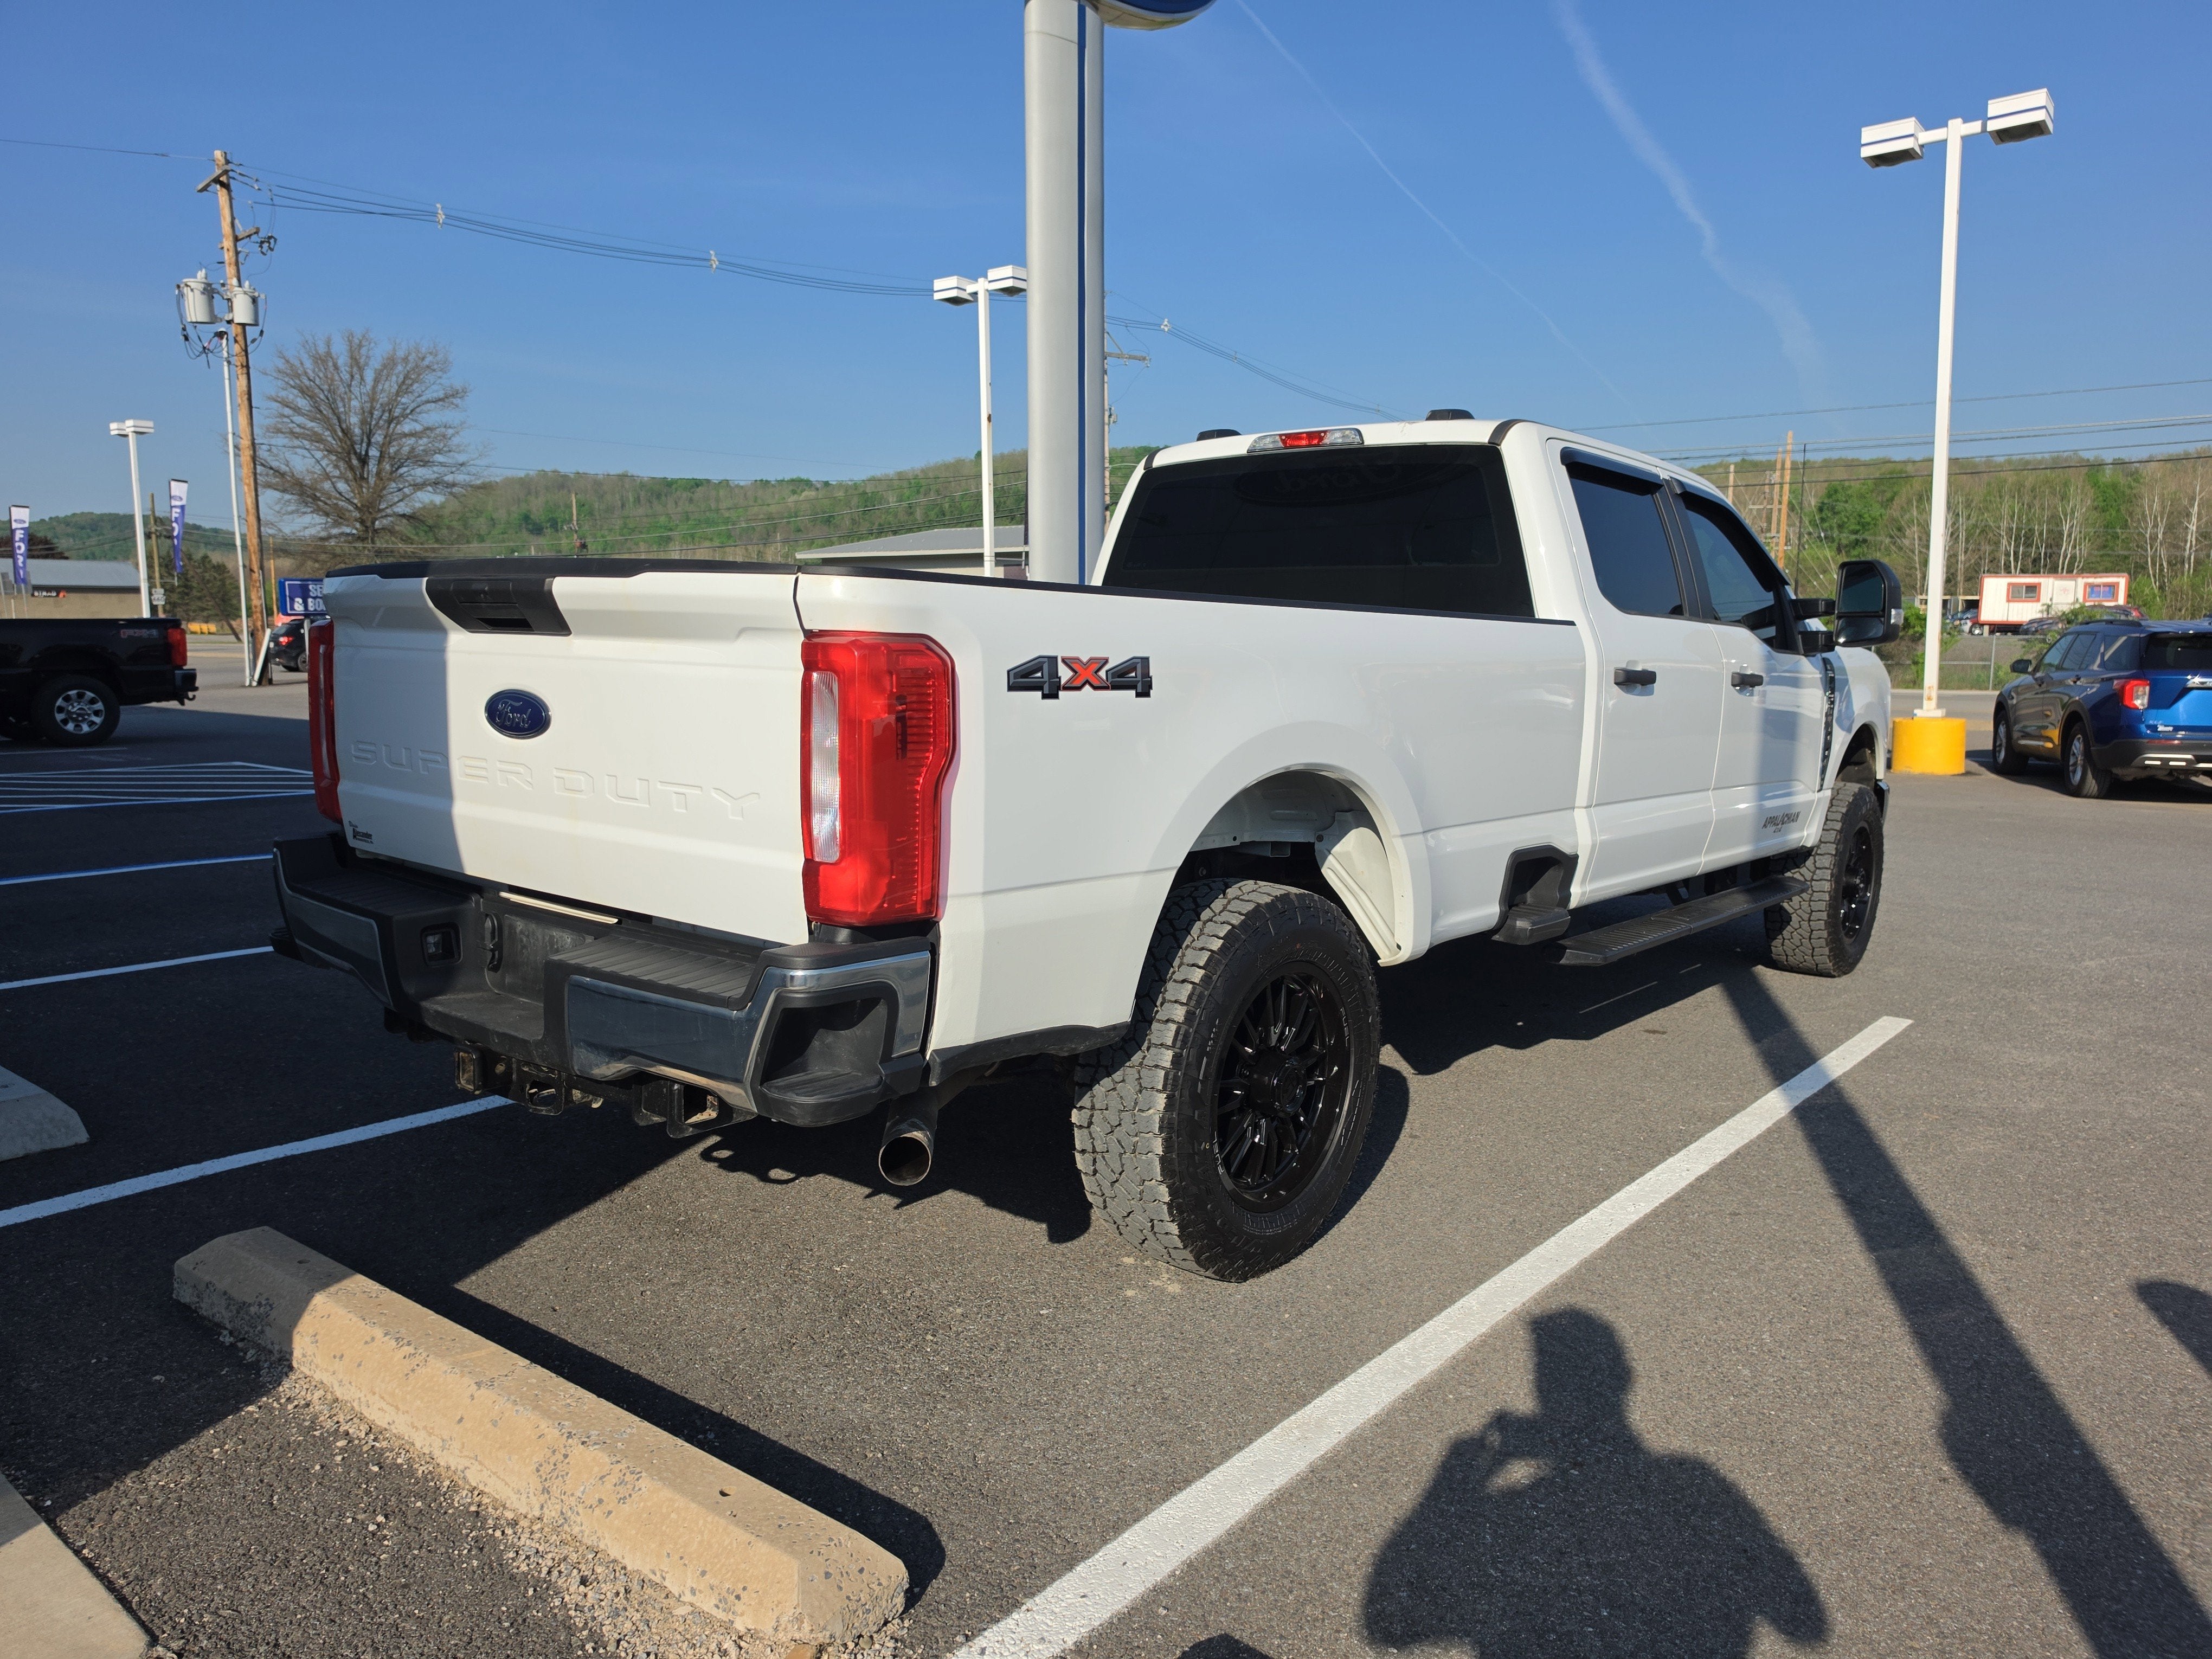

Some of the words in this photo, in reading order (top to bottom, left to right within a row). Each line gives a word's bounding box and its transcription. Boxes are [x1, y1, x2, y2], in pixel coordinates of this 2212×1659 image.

[294, 597, 304, 611] &
[307, 597, 326, 610] BO
[496, 699, 531, 728] Ford
[352, 741, 533, 790] SUPER
[553, 767, 760, 820] DUTY
[1761, 811, 1801, 829] APPALACHIAN
[1340, 1007, 1349, 1047] FUEL
[1213, 1131, 1224, 1175] FUEL
